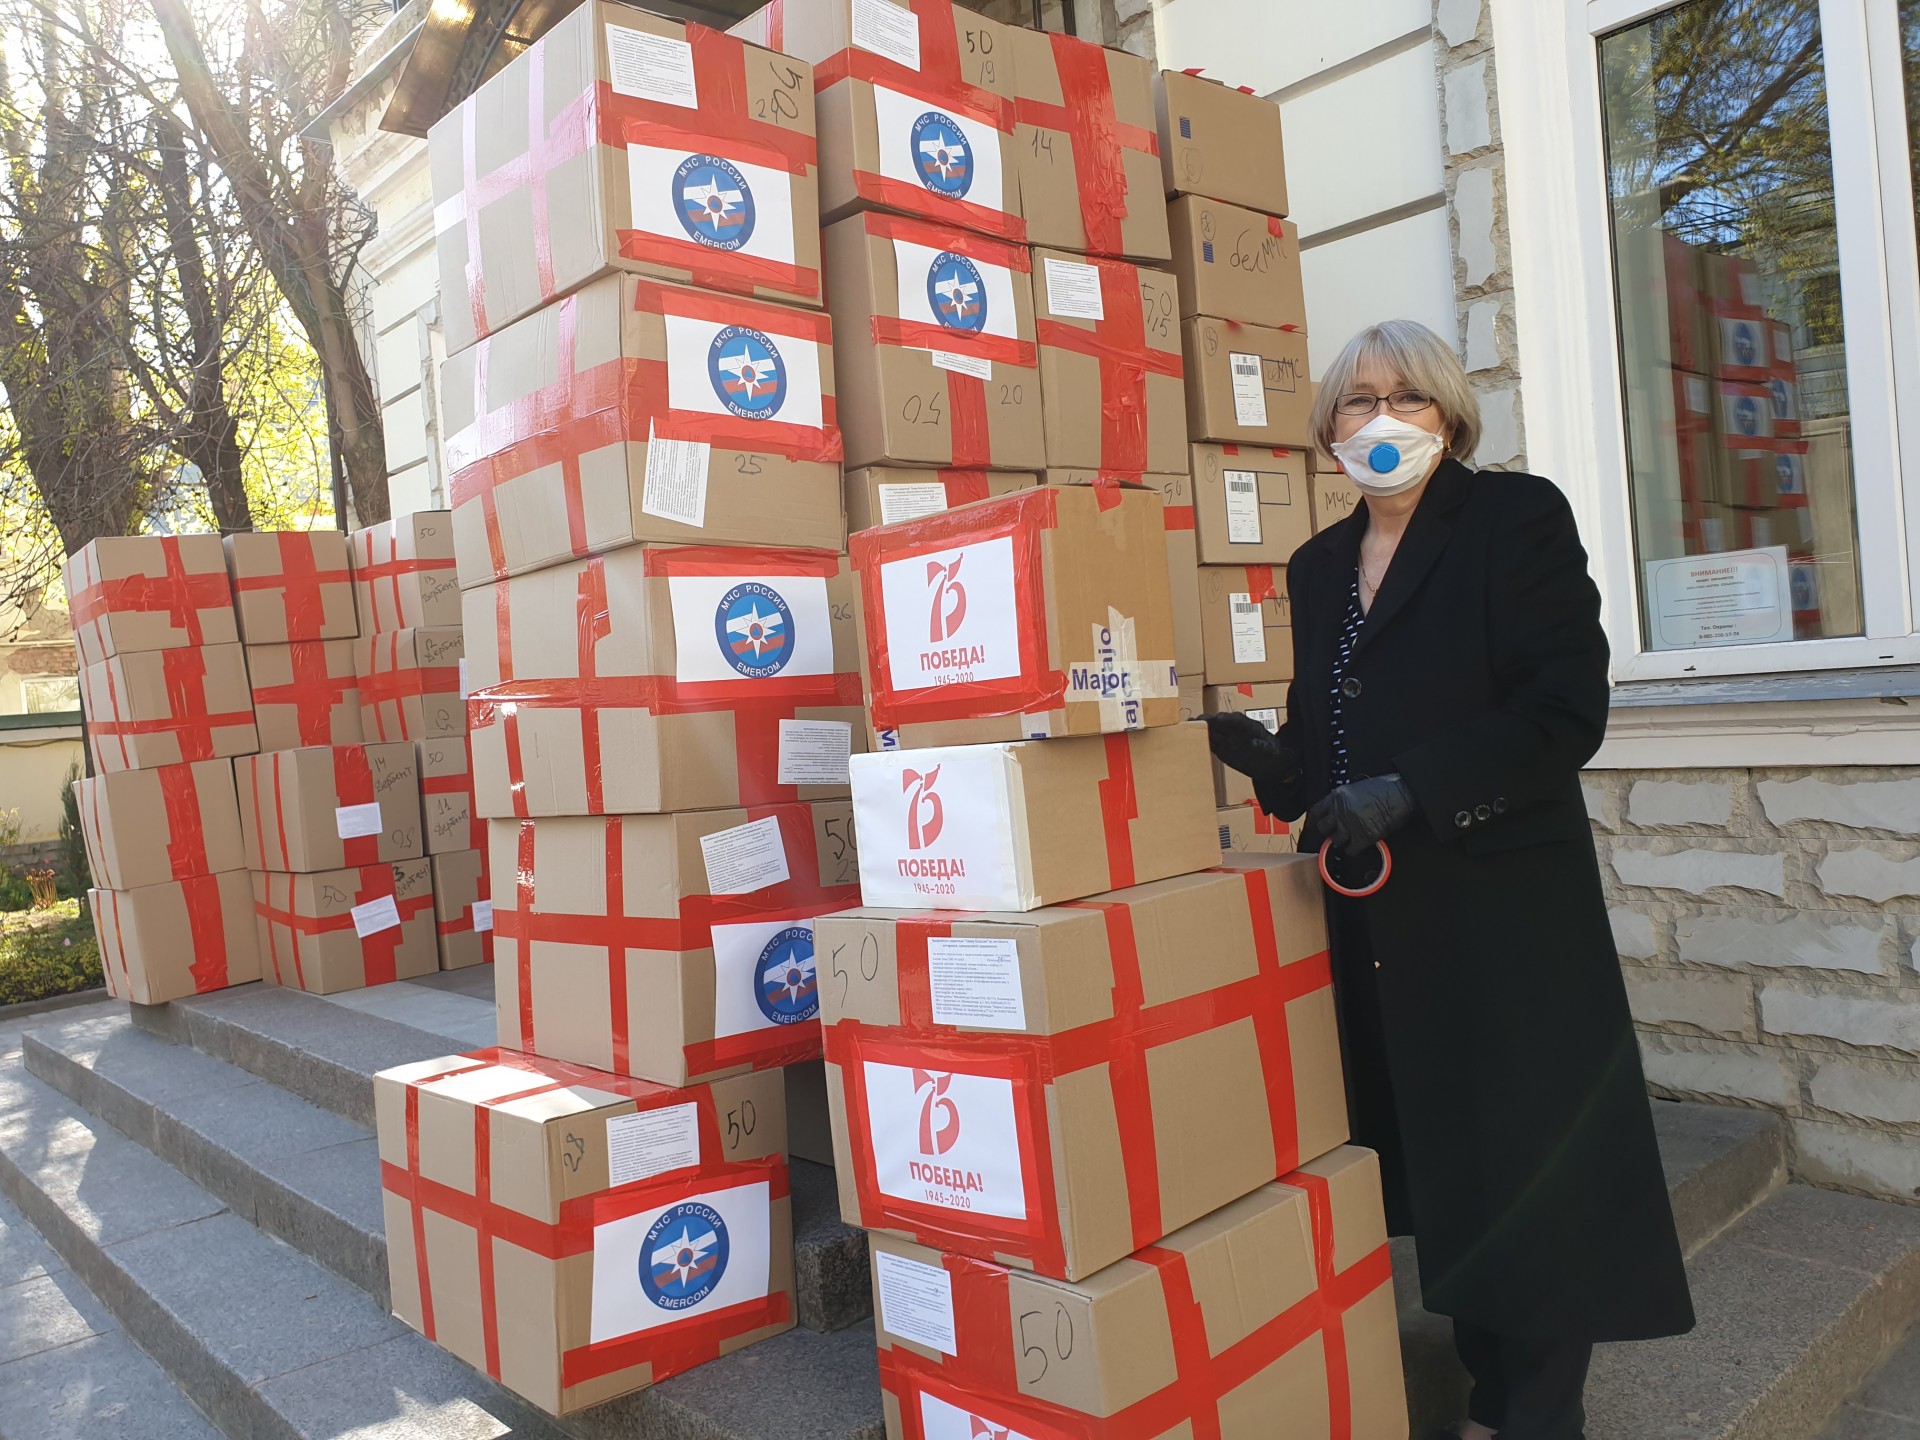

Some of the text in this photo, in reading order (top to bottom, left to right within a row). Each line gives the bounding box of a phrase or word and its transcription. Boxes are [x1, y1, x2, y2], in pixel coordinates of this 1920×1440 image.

[966, 30, 993, 54] 50
[980, 60, 995, 85] 19
[915, 114, 967, 145] МЧС РОССИИ
[1032, 128, 1053, 165] 14
[678, 156, 747, 190] МЧС РОССИИ
[693, 231, 741, 250] EMERCOM
[932, 253, 980, 282] МЧС РОССИИ
[714, 327, 778, 359] МЧС РОССИИ
[1001, 384, 1023, 405] 20
[728, 401, 773, 419] EMERCOM
[735, 454, 767, 475] 25
[420, 527, 436, 539] 50
[721, 585, 787, 611] МЧС РОССИИ
[831, 603, 851, 620] 26
[736, 661, 781, 677] EMERCOM
[920, 645, 985, 671] ПОБЕДА!
[934, 672, 974, 687] 1945-2020
[1072, 668, 1128, 695] Major
[428, 751, 444, 765] 50
[898, 859, 966, 880] ПОБЕДА!
[322, 885, 347, 909] 50
[914, 883, 955, 894] 1945-2020
[761, 929, 814, 961] МЧС РОСС
[832, 931, 879, 1008] 50
[771, 1004, 817, 1024] EMERCOM
[727, 1099, 756, 1150] 50
[909, 1161, 984, 1193] ПОБЕДА!
[924, 1189, 971, 1209] 1945-2020
[648, 1205, 722, 1241] МЧС РОССИИ
[658, 1286, 709, 1308] EMERCOM
[1020, 1300, 1074, 1384] 50
